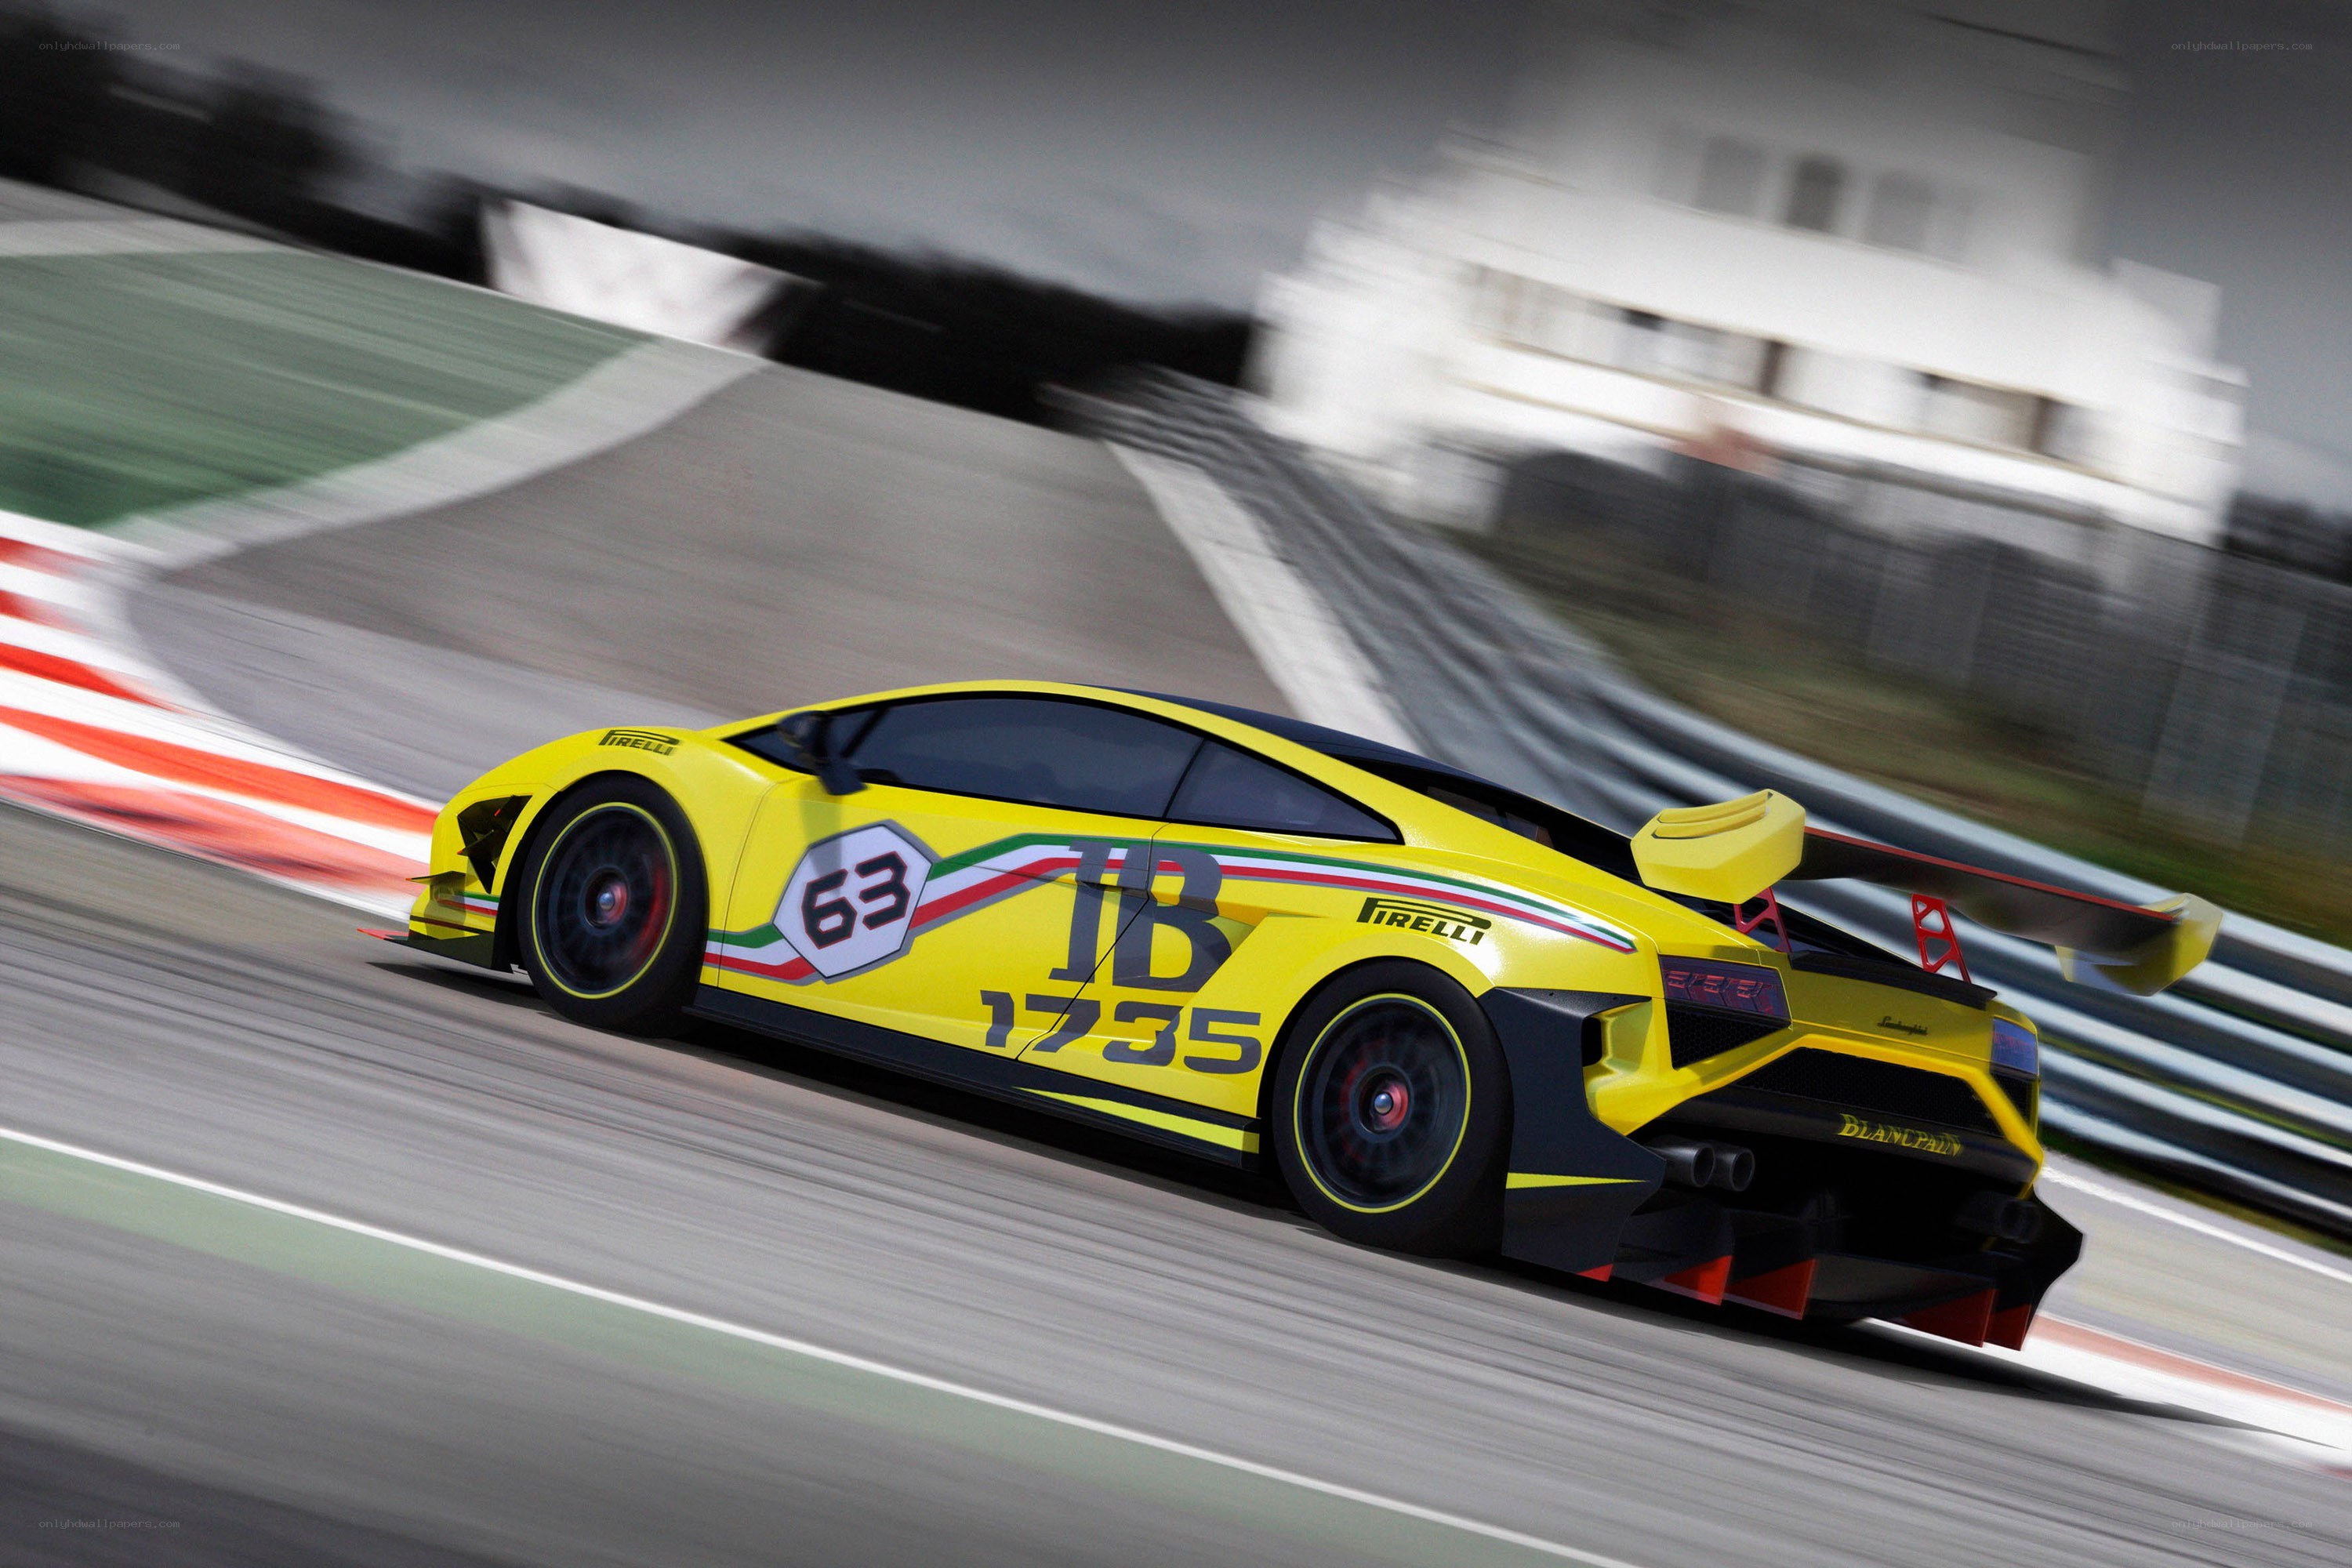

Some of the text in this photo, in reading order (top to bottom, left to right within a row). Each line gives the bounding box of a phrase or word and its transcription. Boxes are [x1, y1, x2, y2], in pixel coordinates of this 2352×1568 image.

[598, 729, 680, 756] PIRELLI
[802, 851, 910, 949] 63
[1356, 897, 1492, 946] PIRELLI
[980, 989, 1262, 1075] 1735
[1838, 1112, 1963, 1158] BLANCPAIN
